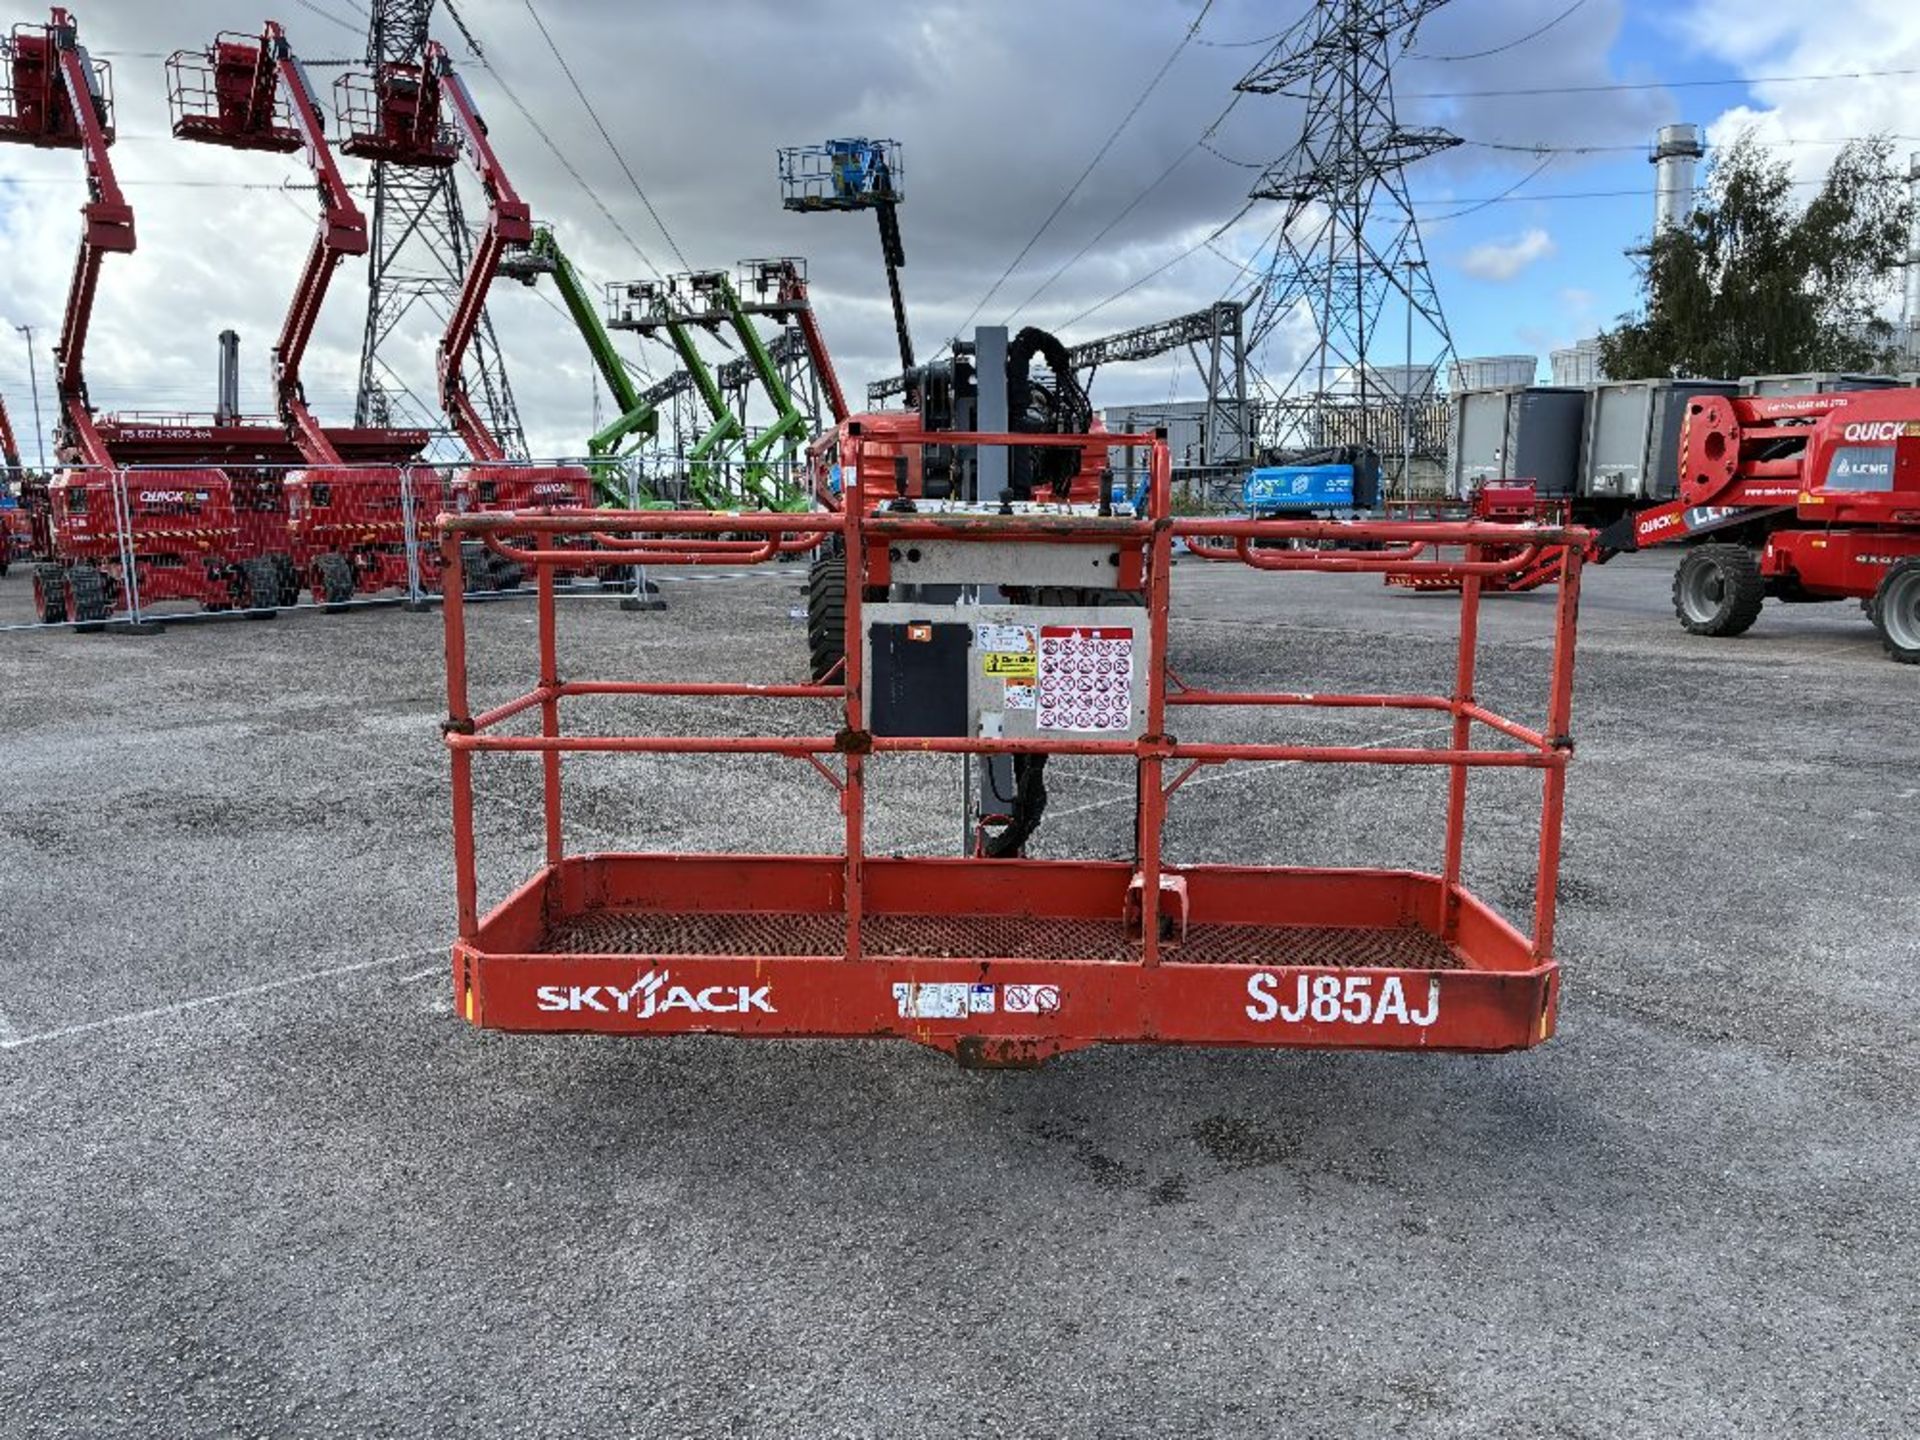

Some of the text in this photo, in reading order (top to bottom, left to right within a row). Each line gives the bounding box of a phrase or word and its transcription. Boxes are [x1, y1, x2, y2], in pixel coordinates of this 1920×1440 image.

[1844, 422, 1907, 441] QUICK
[537, 969, 778, 1019] SKYJACK
[1245, 972, 1440, 1026] SJ85AJ
